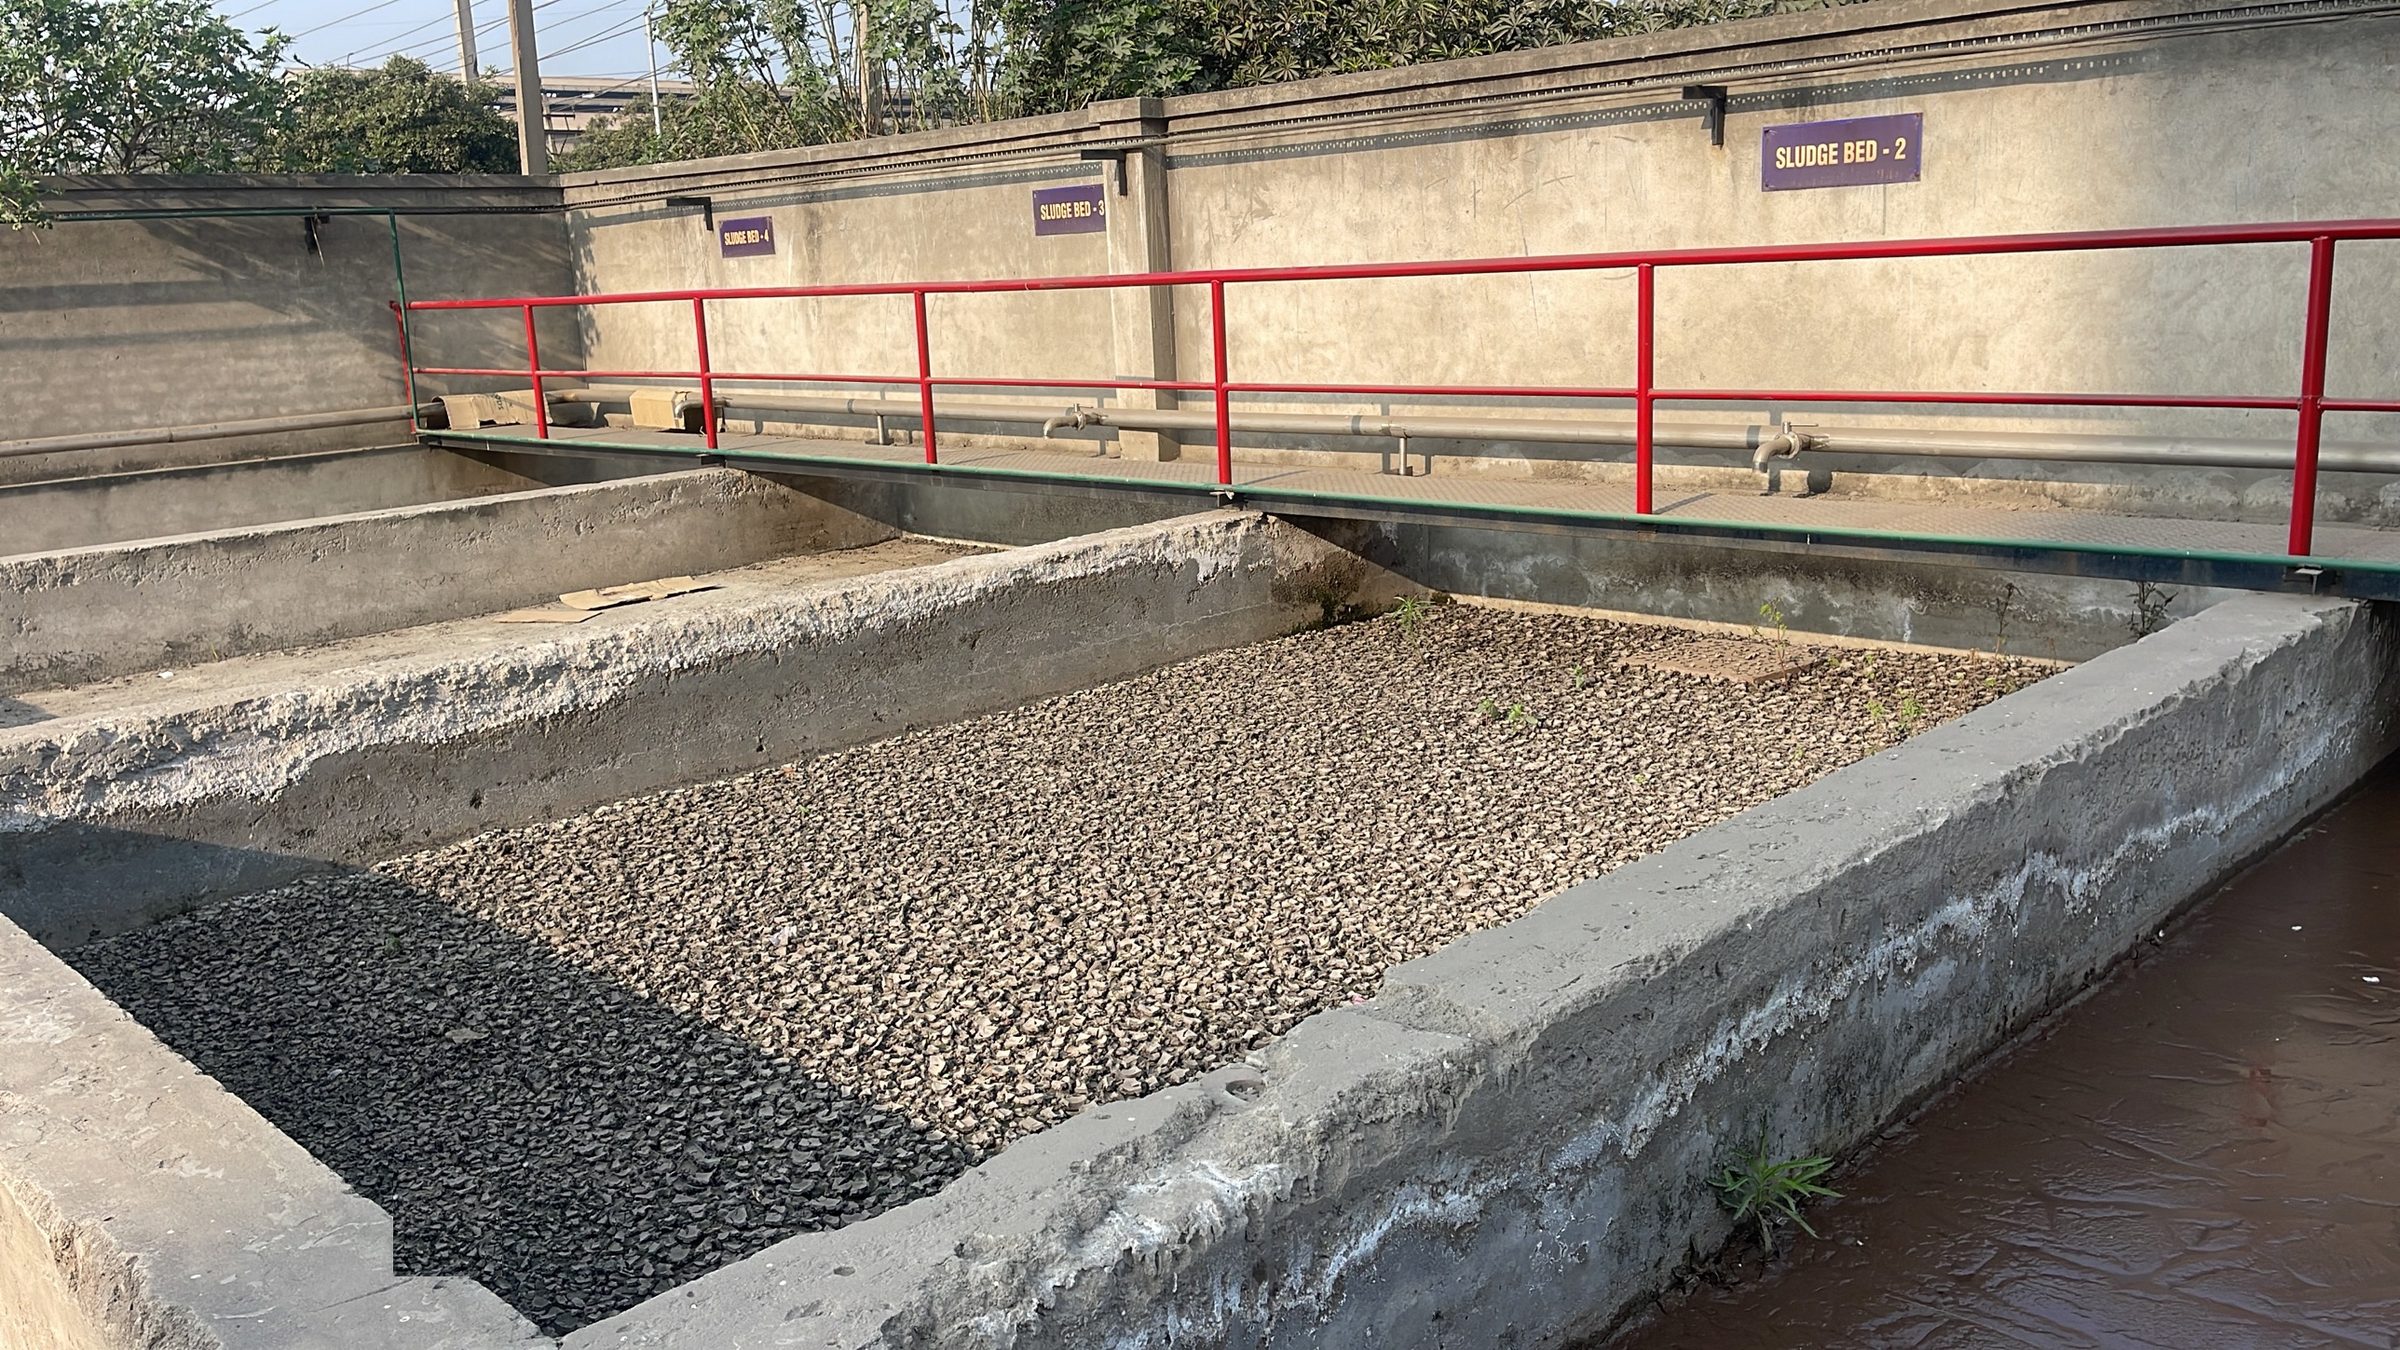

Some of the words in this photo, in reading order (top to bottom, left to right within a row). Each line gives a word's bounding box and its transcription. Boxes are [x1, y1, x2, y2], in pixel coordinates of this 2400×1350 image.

[1776, 142, 1838, 169] SLUDGE
[1843, 140, 1877, 164] BED
[1894, 137, 1907, 160] 2
[1040, 202, 1072, 220] SLUDGE
[1073, 201, 1091, 217] BED
[1098, 200, 1105, 216] 3
[724, 231, 747, 245] SLUDGE
[747, 230, 760, 243] BED
[764, 229, 769, 242] 4
